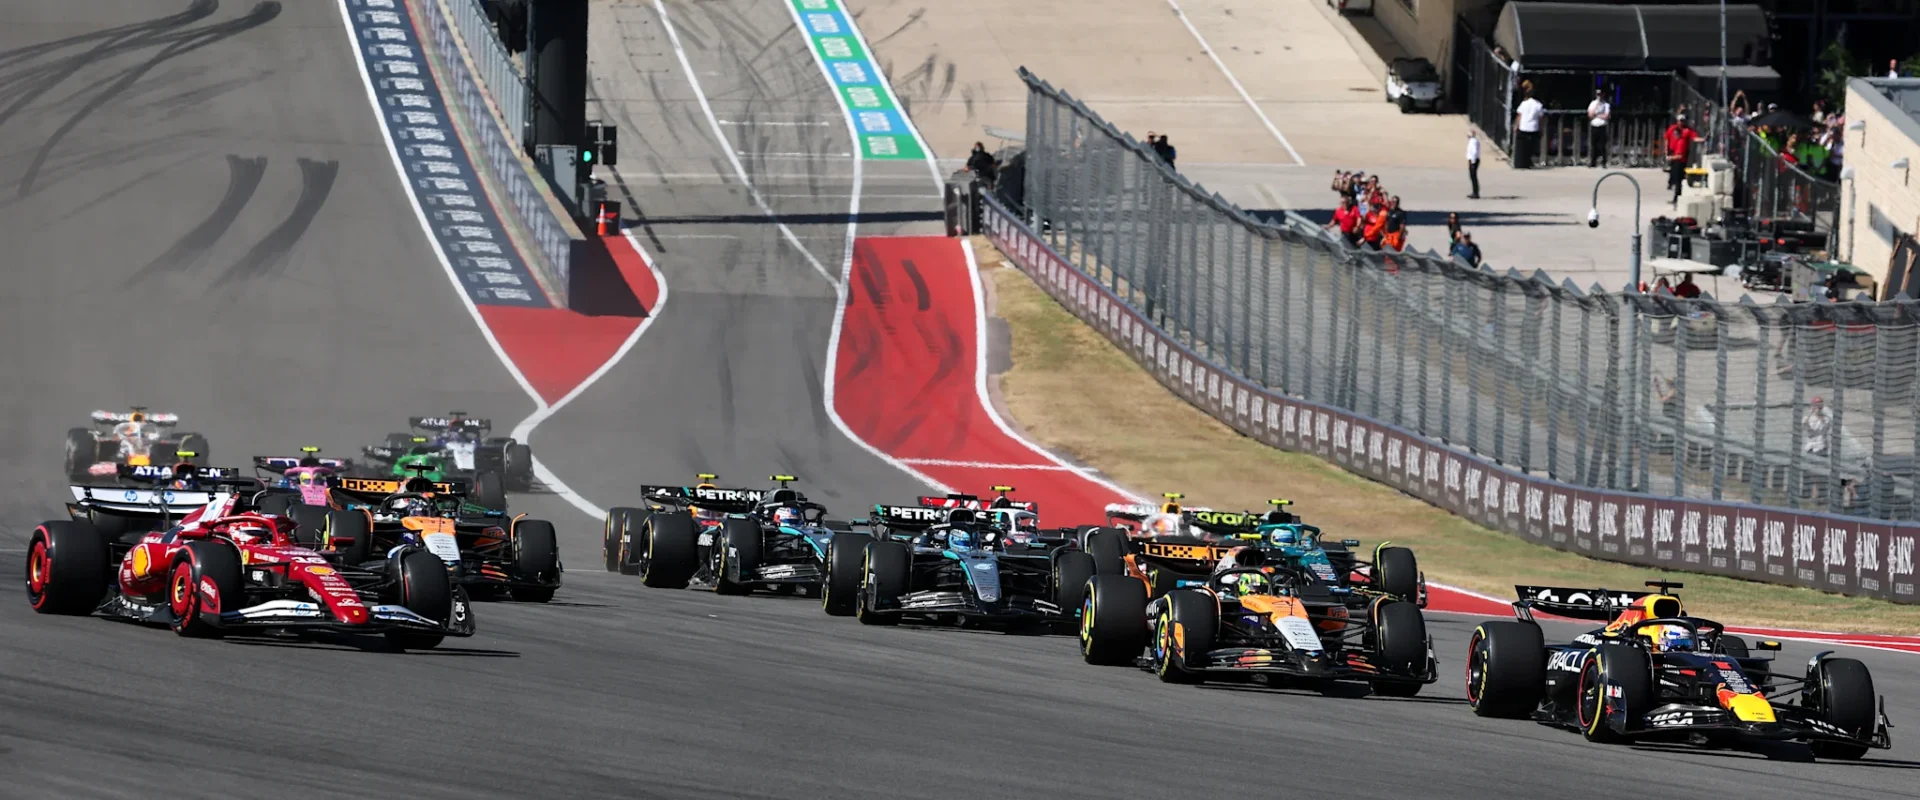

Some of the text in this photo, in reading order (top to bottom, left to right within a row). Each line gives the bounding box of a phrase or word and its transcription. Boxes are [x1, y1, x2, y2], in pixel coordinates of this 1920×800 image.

[696, 488, 762, 502] PETRON
[1658, 508, 1674, 542] MSC
[1687, 510, 1701, 545] MSC
[1712, 514, 1728, 550] MSC
[1741, 517, 1757, 553] MSC
[1770, 520, 1785, 557] MSC
[1800, 524, 1816, 562] MSC
[1830, 528, 1847, 567] MSC
[1862, 532, 1880, 572] MSC
[1896, 536, 1915, 575] MSC
[1547, 651, 1588, 673] ORACL
